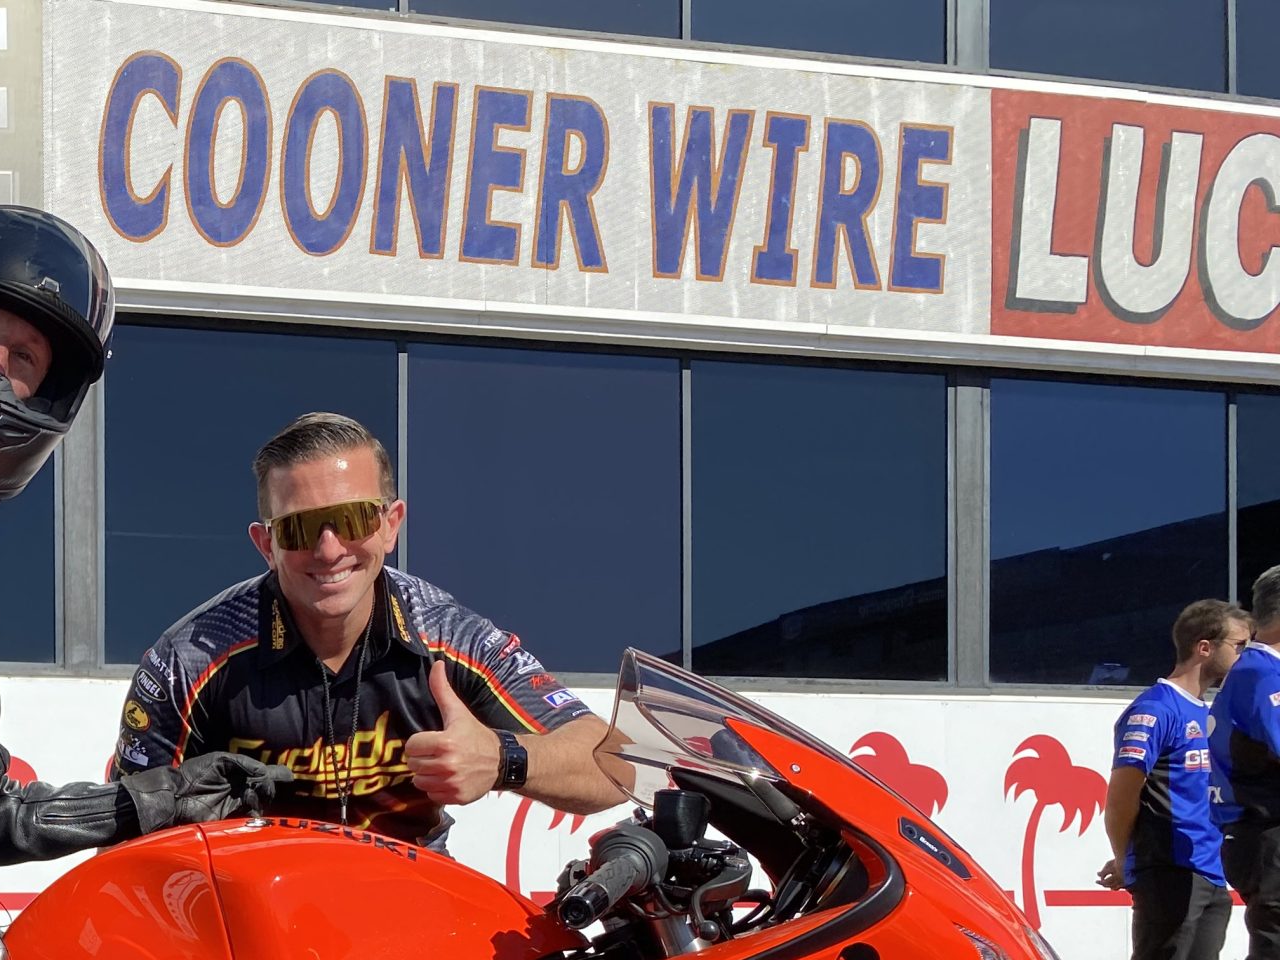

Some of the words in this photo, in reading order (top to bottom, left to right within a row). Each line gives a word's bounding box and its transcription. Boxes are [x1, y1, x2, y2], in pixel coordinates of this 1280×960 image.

[98, 50, 609, 273] COONER
[648, 101, 955, 294] WIRE
[138, 671, 160, 698] PINGEL
[265, 818, 417, 862] UZUKI
